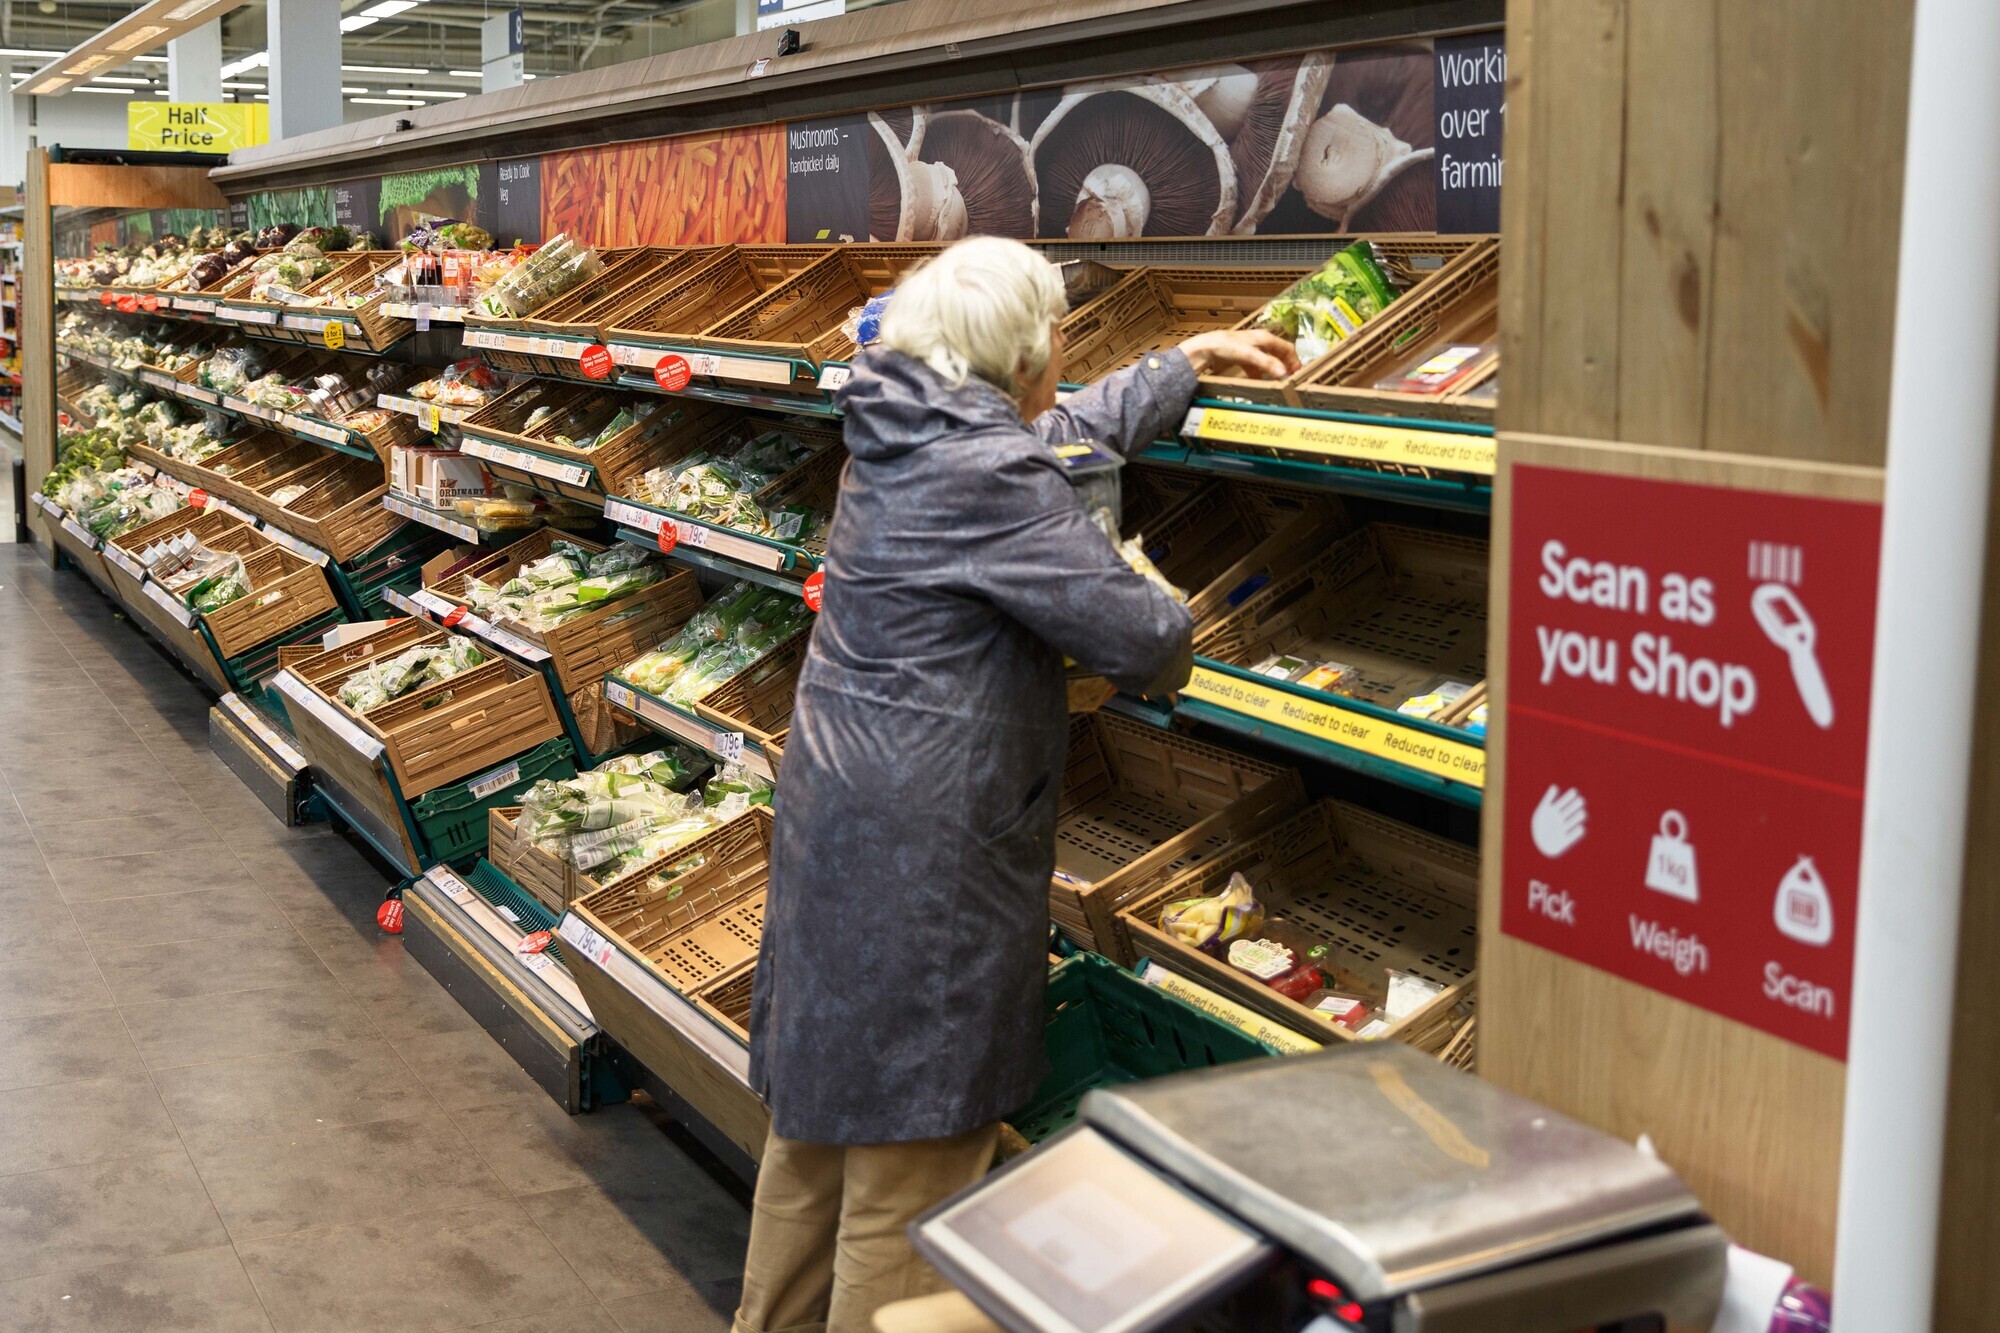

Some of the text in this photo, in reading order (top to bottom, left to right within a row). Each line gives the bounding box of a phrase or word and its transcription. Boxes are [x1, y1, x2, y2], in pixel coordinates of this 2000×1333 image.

[515, 15, 522, 45] 8
[1440, 46, 1508, 88] Worki
[168, 107, 207, 125] Half
[1440, 108, 1490, 139] over
[161, 127, 213, 146] Price
[789, 124, 839, 151] Mushrooms
[499, 162, 530, 183] Ready to Cook
[789, 153, 840, 178] handpicked daily
[1440, 153, 1506, 190] farmi
[499, 187, 509, 205] Veg
[581, 350, 608, 363] You won't
[584, 355, 609, 369] pay more
[656, 359, 685, 375] You won't
[659, 365, 687, 381] pay more
[1206, 416, 1248, 434] Reduced
[1248, 421, 1259, 435] to
[1260, 423, 1287, 439] clear
[1299, 427, 1345, 446] Reduced
[1346, 431, 1358, 447] to
[1360, 434, 1389, 450] clear
[1404, 439, 1456, 460] Reduced
[1458, 443, 1472, 461] to
[1474, 448, 1496, 463] cle
[440, 487, 485, 498] ORDINARY
[689, 524, 704, 544] 79c
[804, 585, 819, 593] You
[1538, 539, 1716, 628] Scan as
[1536, 624, 1758, 729] you Shop
[1191, 672, 1486, 775] Reduced to clear Reduced to clear Reduced to clear
[723, 733, 740, 752] 79c
[1657, 853, 1688, 886] 1kg
[1527, 879, 1576, 925] Pick
[382, 915, 391, 926] You
[577, 926, 597, 953] 79c
[1627, 912, 1710, 976] Weigh
[1761, 960, 1835, 1019] Scan
[1166, 980, 1208, 1011] Reduced
[1207, 1001, 1220, 1016] to
[1219, 1008, 1247, 1029] clear
